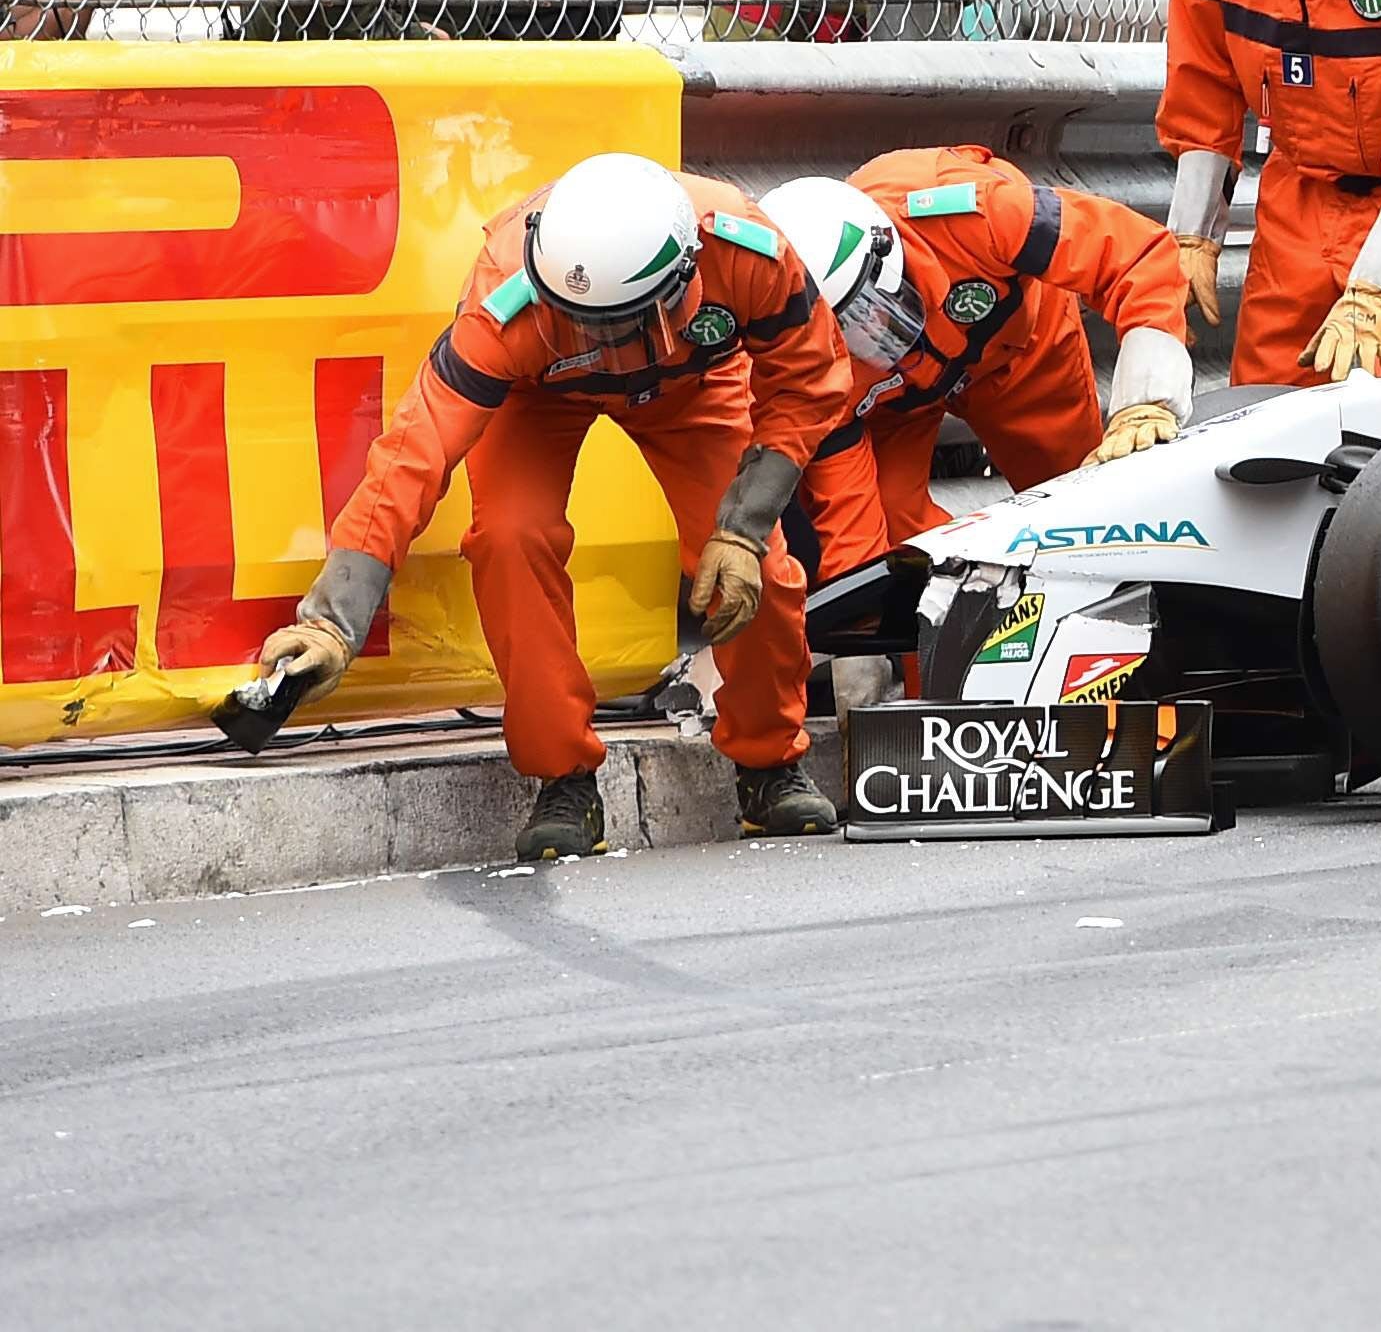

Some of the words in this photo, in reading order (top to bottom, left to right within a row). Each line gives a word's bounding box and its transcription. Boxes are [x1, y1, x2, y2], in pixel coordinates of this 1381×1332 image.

[1290, 57, 1304, 83] 5
[637, 390, 652, 404] 5
[1005, 519, 1211, 554] ASTANA
[920, 715, 1068, 774] ROYAL
[855, 763, 1136, 815] CHALLENGE
